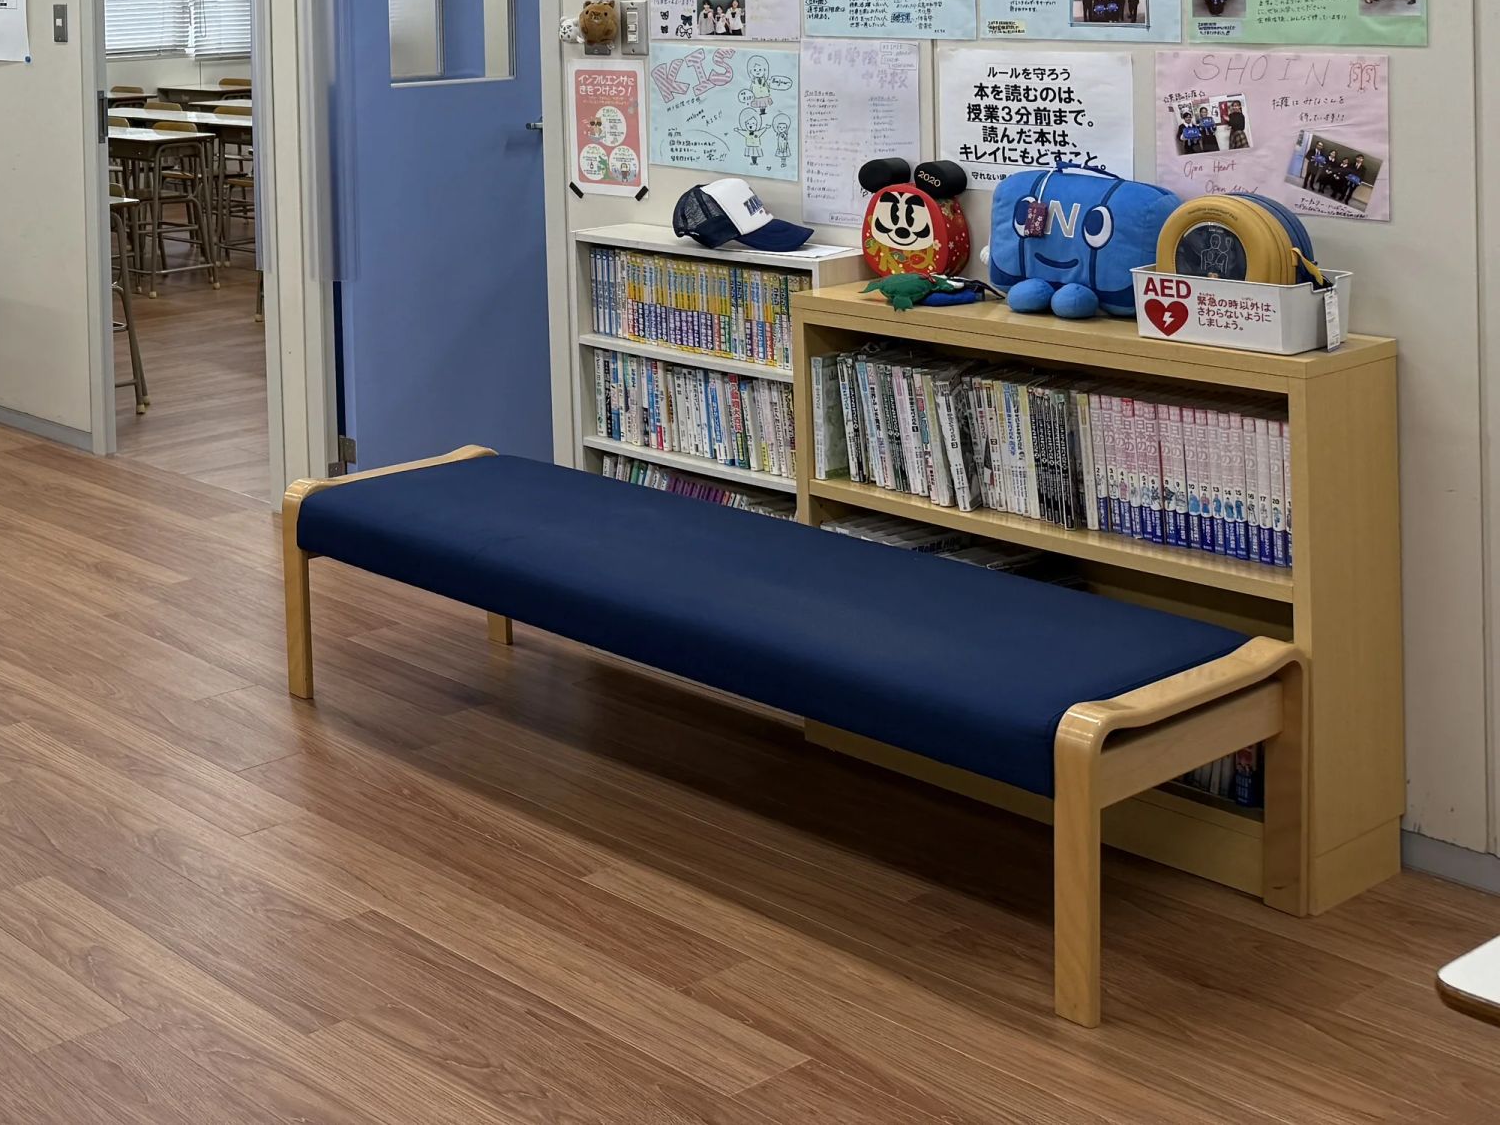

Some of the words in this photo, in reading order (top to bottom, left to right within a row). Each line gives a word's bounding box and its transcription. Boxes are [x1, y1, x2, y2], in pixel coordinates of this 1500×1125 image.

[650, 48, 736, 104] KIS
[988, 66, 1071, 81] ルールを守ろう
[1193, 54, 1331, 88] SHOIN
[579, 85, 632, 96] きをつけよう!
[974, 82, 1084, 105] 本を読むのは、
[967, 103, 1094, 128] 授業3分前まで。
[982, 125, 1078, 148] 読んだ本は、
[959, 143, 1107, 171] キレイにもどすこと。
[1213, 159, 1237, 172] Heart
[917, 170, 941, 187] 2020
[1205, 180, 1228, 195] Open
[1044, 199, 1081, 238] N
[1144, 277, 1192, 300] AED
[1197, 295, 1277, 314] 緊急の時以外は、
[1197, 307, 1272, 323] さわらないように
[1198, 318, 1244, 331] しましょう。
